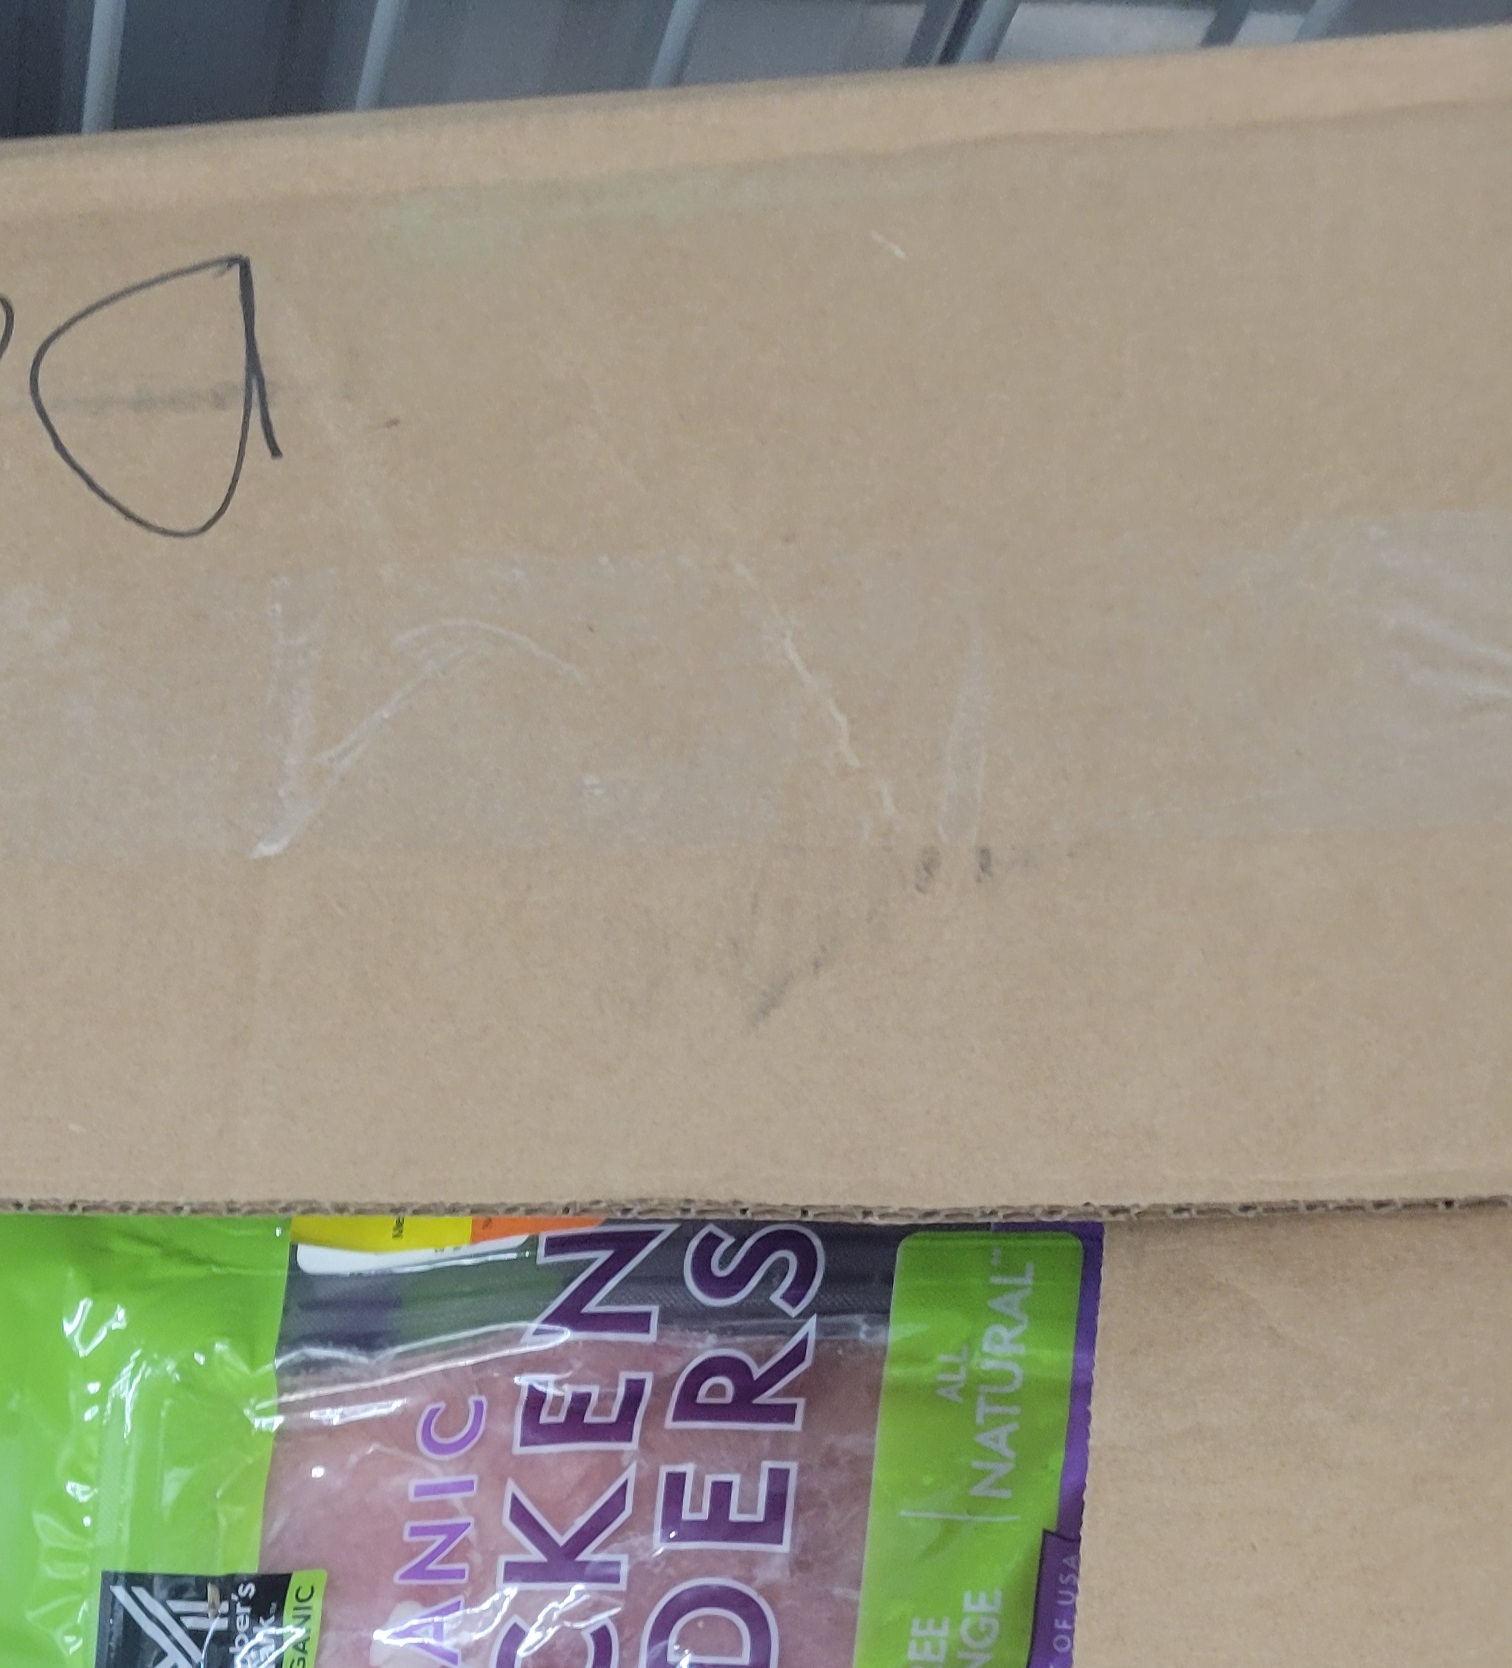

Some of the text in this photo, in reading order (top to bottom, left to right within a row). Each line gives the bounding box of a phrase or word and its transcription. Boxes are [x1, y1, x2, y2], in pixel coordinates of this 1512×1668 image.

[936, 1346, 968, 1403] ALL
[1053, 1552, 1081, 1608] USA
[1050, 1617, 1075, 1655] OF
